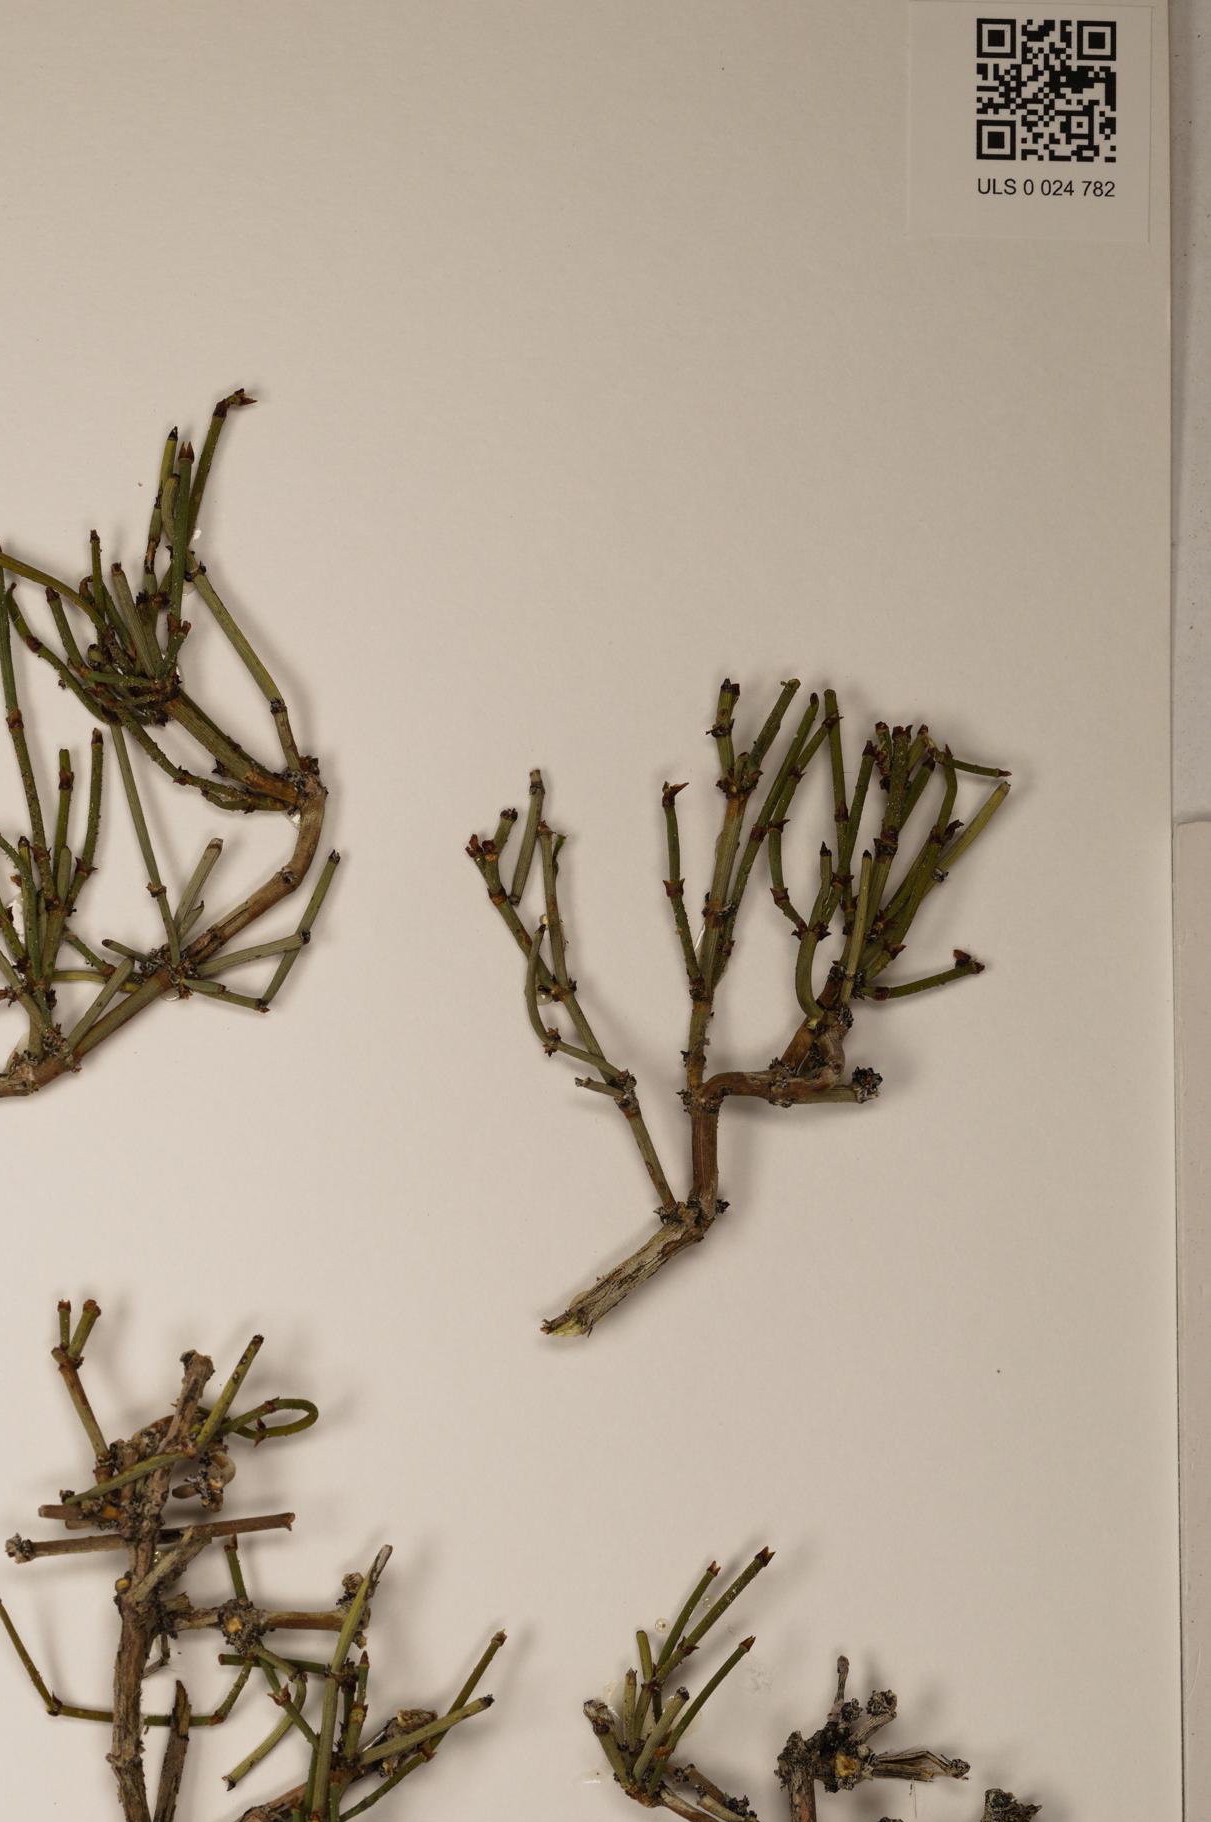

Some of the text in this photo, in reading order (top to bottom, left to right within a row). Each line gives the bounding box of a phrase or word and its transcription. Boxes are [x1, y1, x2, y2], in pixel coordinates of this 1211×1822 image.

[977, 177, 1116, 198] ULS 0 024 782
